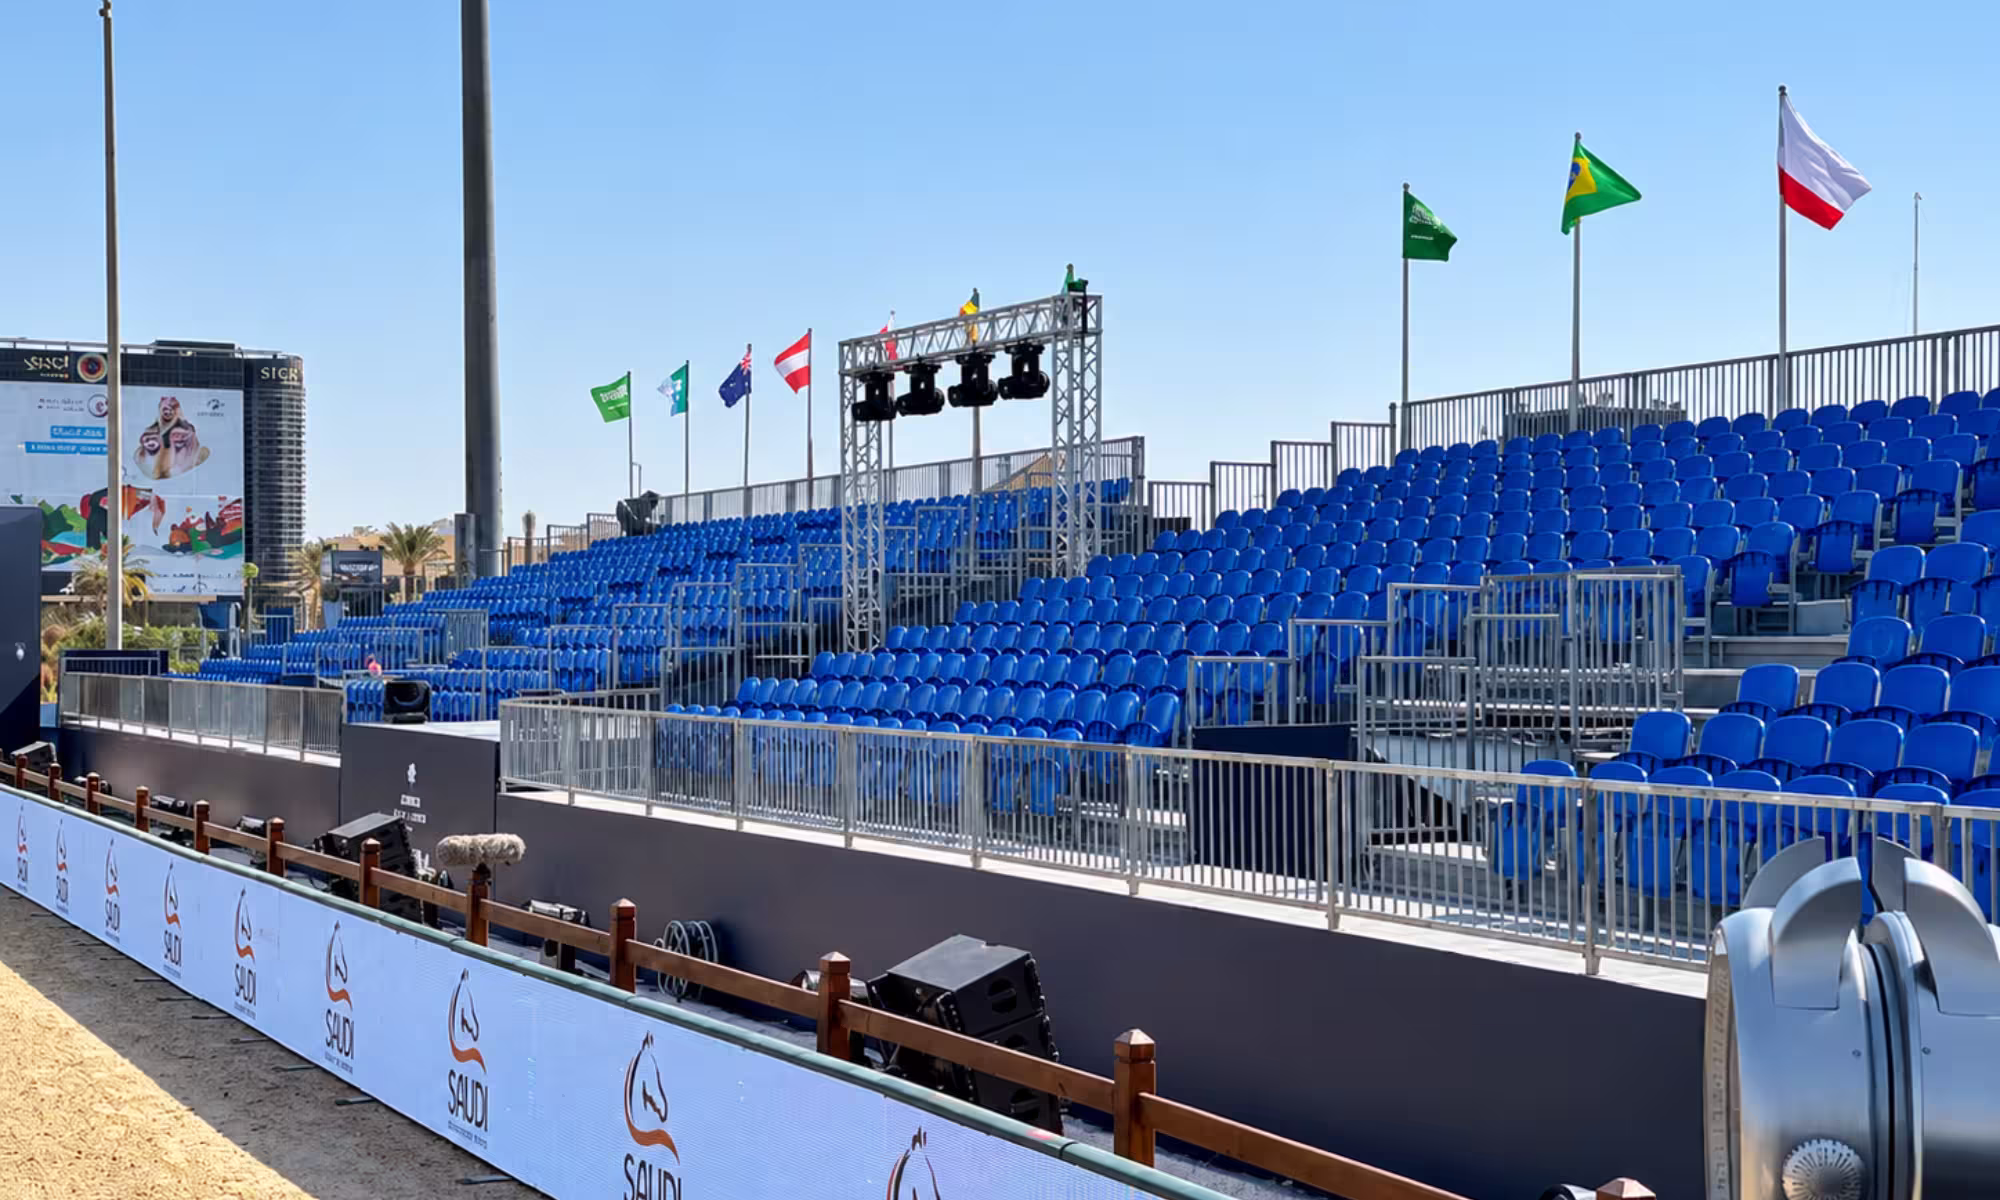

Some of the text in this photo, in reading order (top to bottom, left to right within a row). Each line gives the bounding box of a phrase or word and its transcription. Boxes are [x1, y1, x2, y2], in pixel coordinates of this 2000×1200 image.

[164, 930, 181, 967] SAUDI
[235, 963, 256, 1007] SAUDI
[326, 1009, 354, 1060] SAUDI
[448, 1069, 488, 1132] SAUDI
